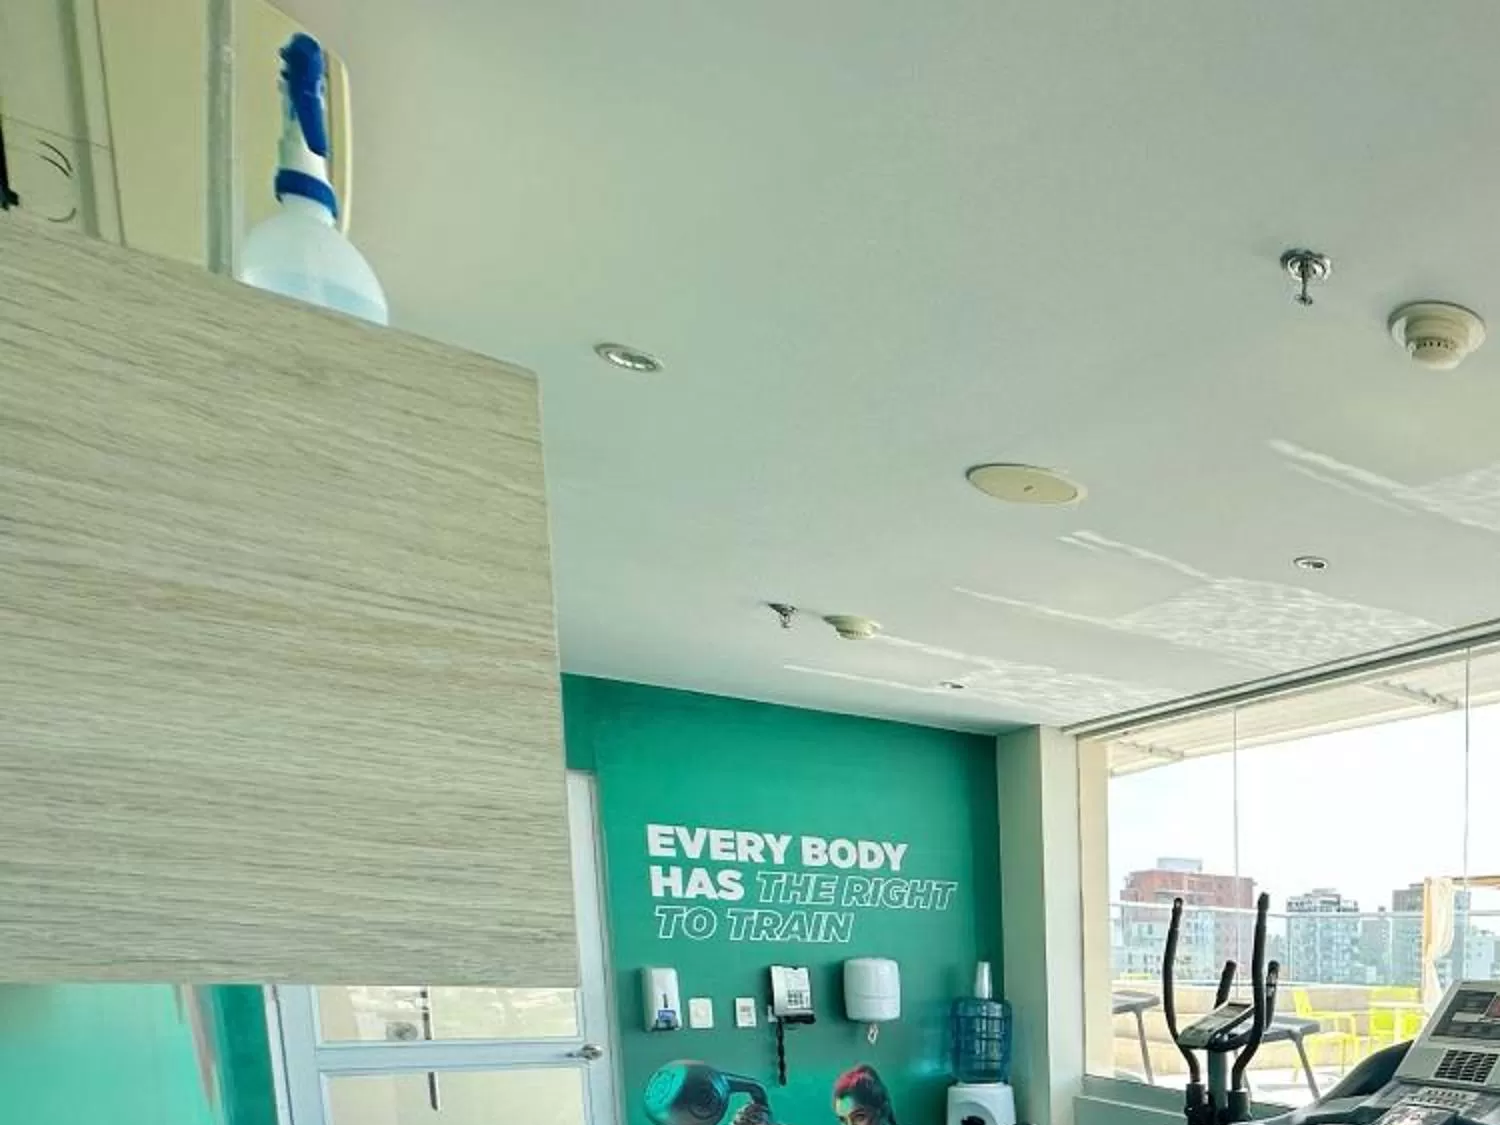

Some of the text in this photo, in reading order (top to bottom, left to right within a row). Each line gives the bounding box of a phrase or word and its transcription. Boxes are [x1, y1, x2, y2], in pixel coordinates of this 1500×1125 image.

[646, 824, 908, 871] EVERY BODY
[650, 865, 958, 910] HAS THE RIGHT
[655, 905, 855, 942] TO TRAIN
